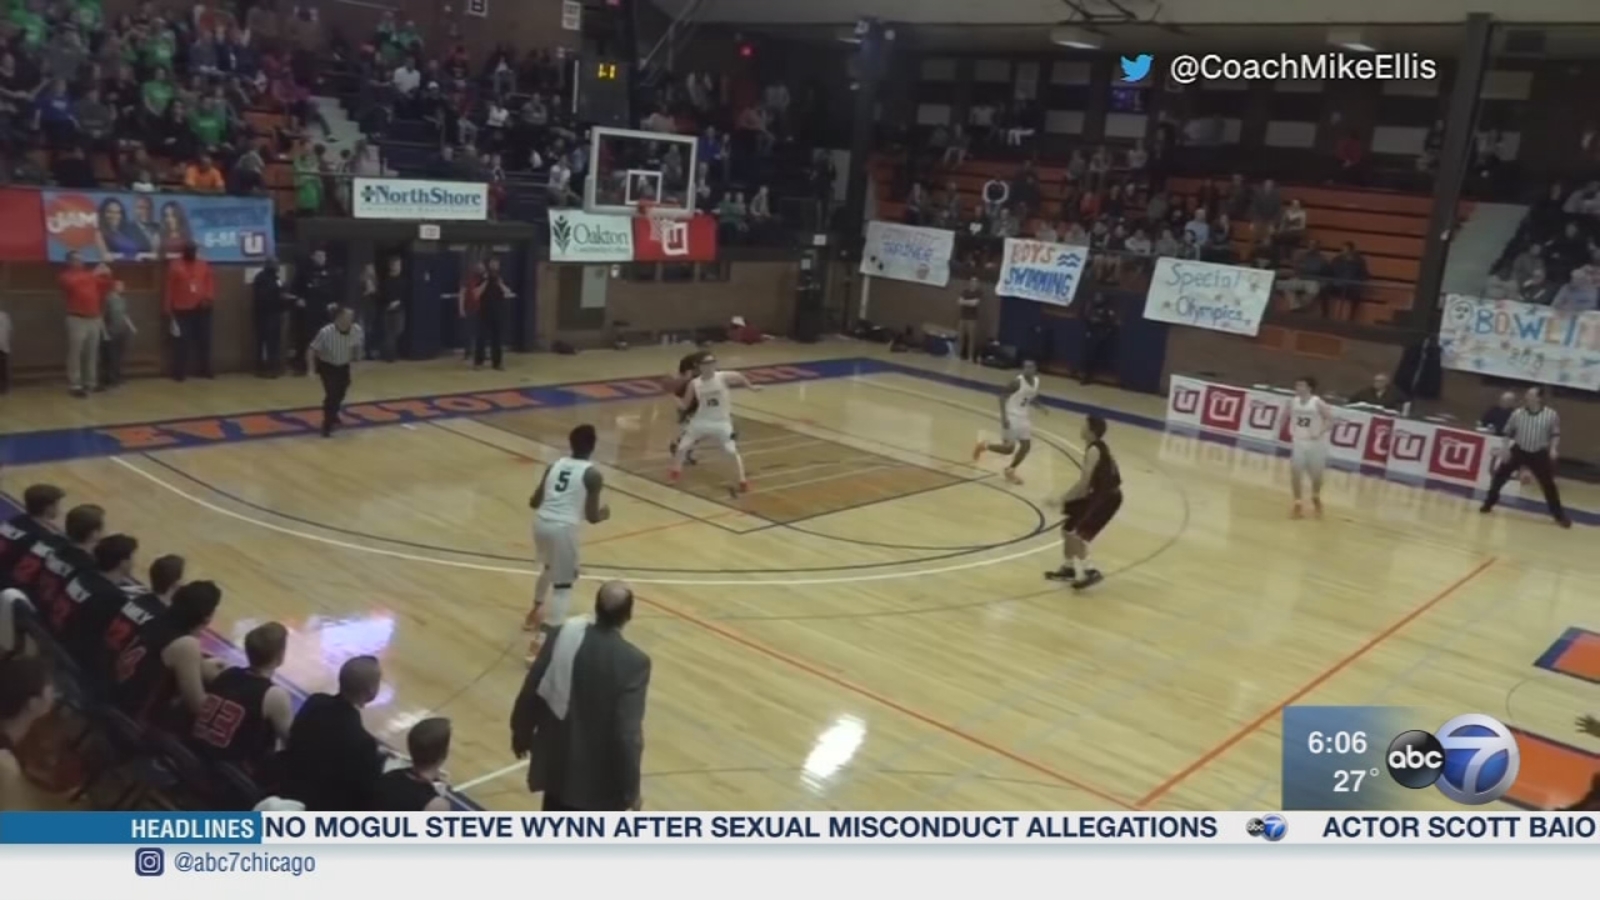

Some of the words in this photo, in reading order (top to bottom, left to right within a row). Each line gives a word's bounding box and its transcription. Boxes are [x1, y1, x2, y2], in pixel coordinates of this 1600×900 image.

[374, 185, 482, 206] NorthShore
[573, 222, 630, 246] Oakton
[1010, 242, 1056, 264] BOYS
[1165, 262, 1241, 294] Special
[555, 471, 571, 492] 5
